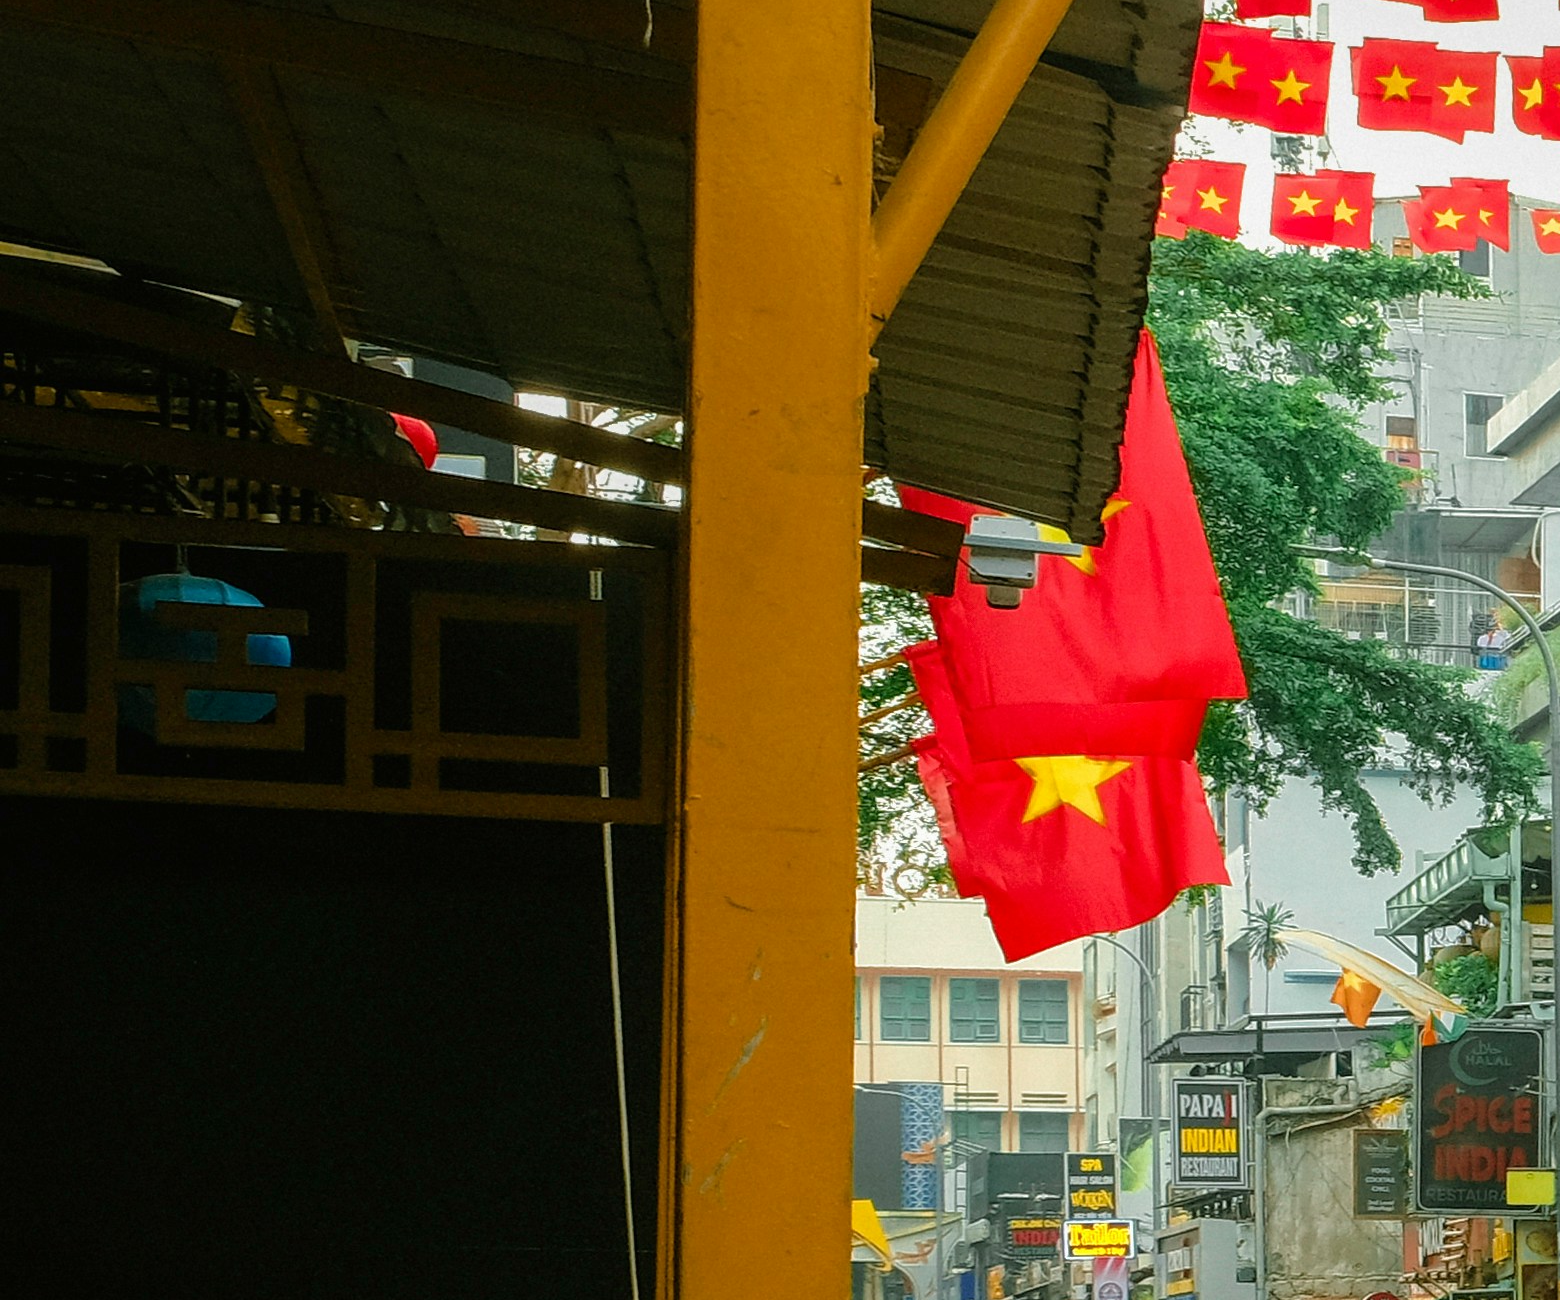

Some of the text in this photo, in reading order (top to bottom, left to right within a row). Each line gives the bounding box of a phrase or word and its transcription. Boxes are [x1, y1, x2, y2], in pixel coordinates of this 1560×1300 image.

[1465, 1054, 1512, 1066] HALAL
[1427, 1084, 1532, 1139] SPICE
[1181, 1128, 1237, 1154] INDIAN
[1180, 1156, 1238, 1179] RESTAURANT
[1433, 1143, 1529, 1181] INDIA
[1425, 1187, 1507, 1202] RESTAURA
[1069, 1223, 1130, 1247] Tailor
